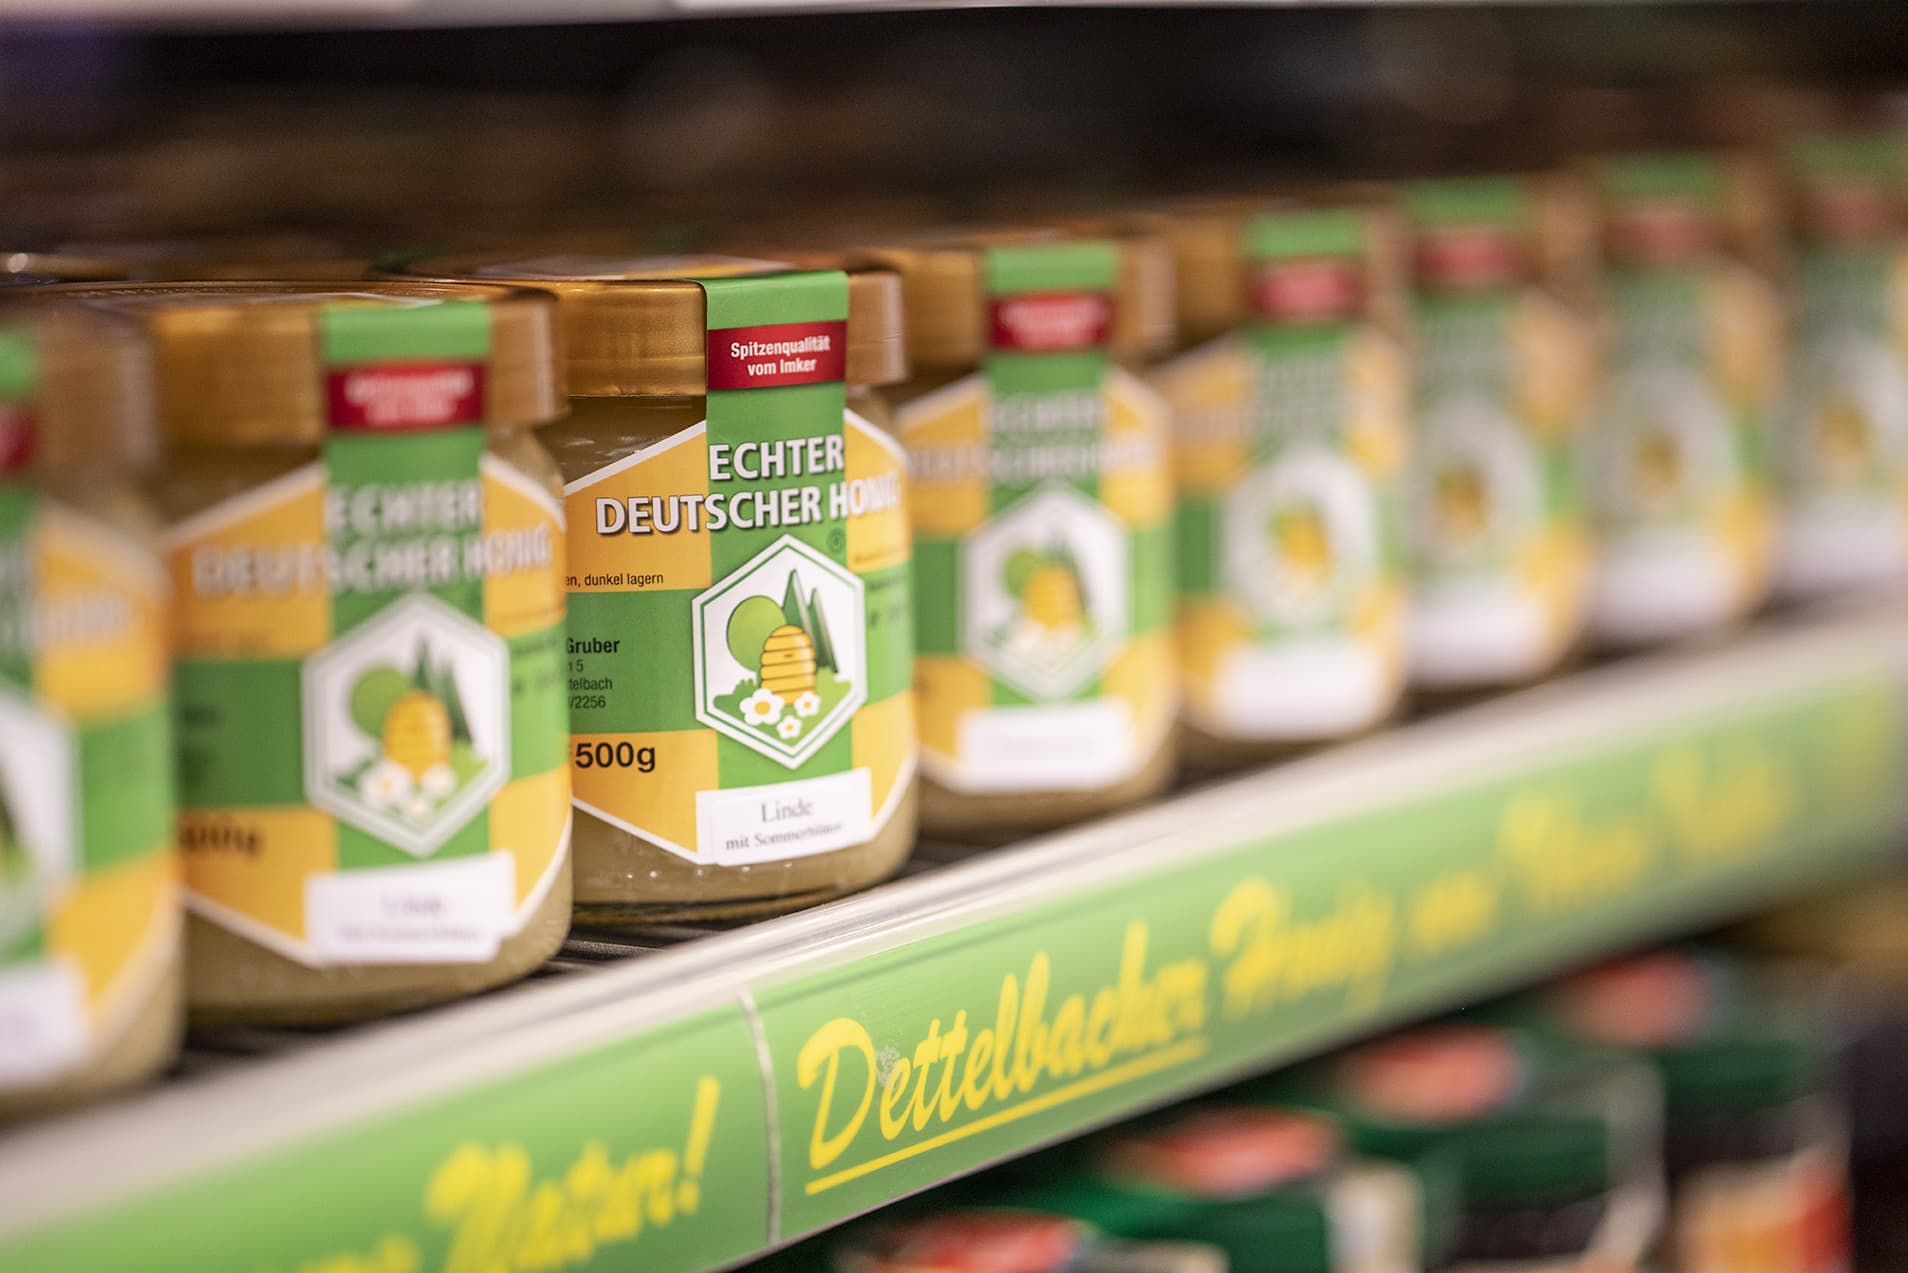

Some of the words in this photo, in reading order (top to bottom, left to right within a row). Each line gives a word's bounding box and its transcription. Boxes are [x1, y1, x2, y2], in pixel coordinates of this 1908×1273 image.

[731, 335, 830, 360] Spitzenqualität
[747, 362, 776, 376] vom
[780, 357, 817, 374] Imker
[708, 434, 845, 482] ECHTER
[595, 485, 823, 536] DEUTSCHER
[584, 573, 624, 586] dunkel
[626, 572, 664, 587] lagern
[575, 741, 656, 773] 500g
[761, 797, 813, 823] Linde
[725, 837, 750, 850] mit
[797, 918, 1209, 1170] Dettelbacher
